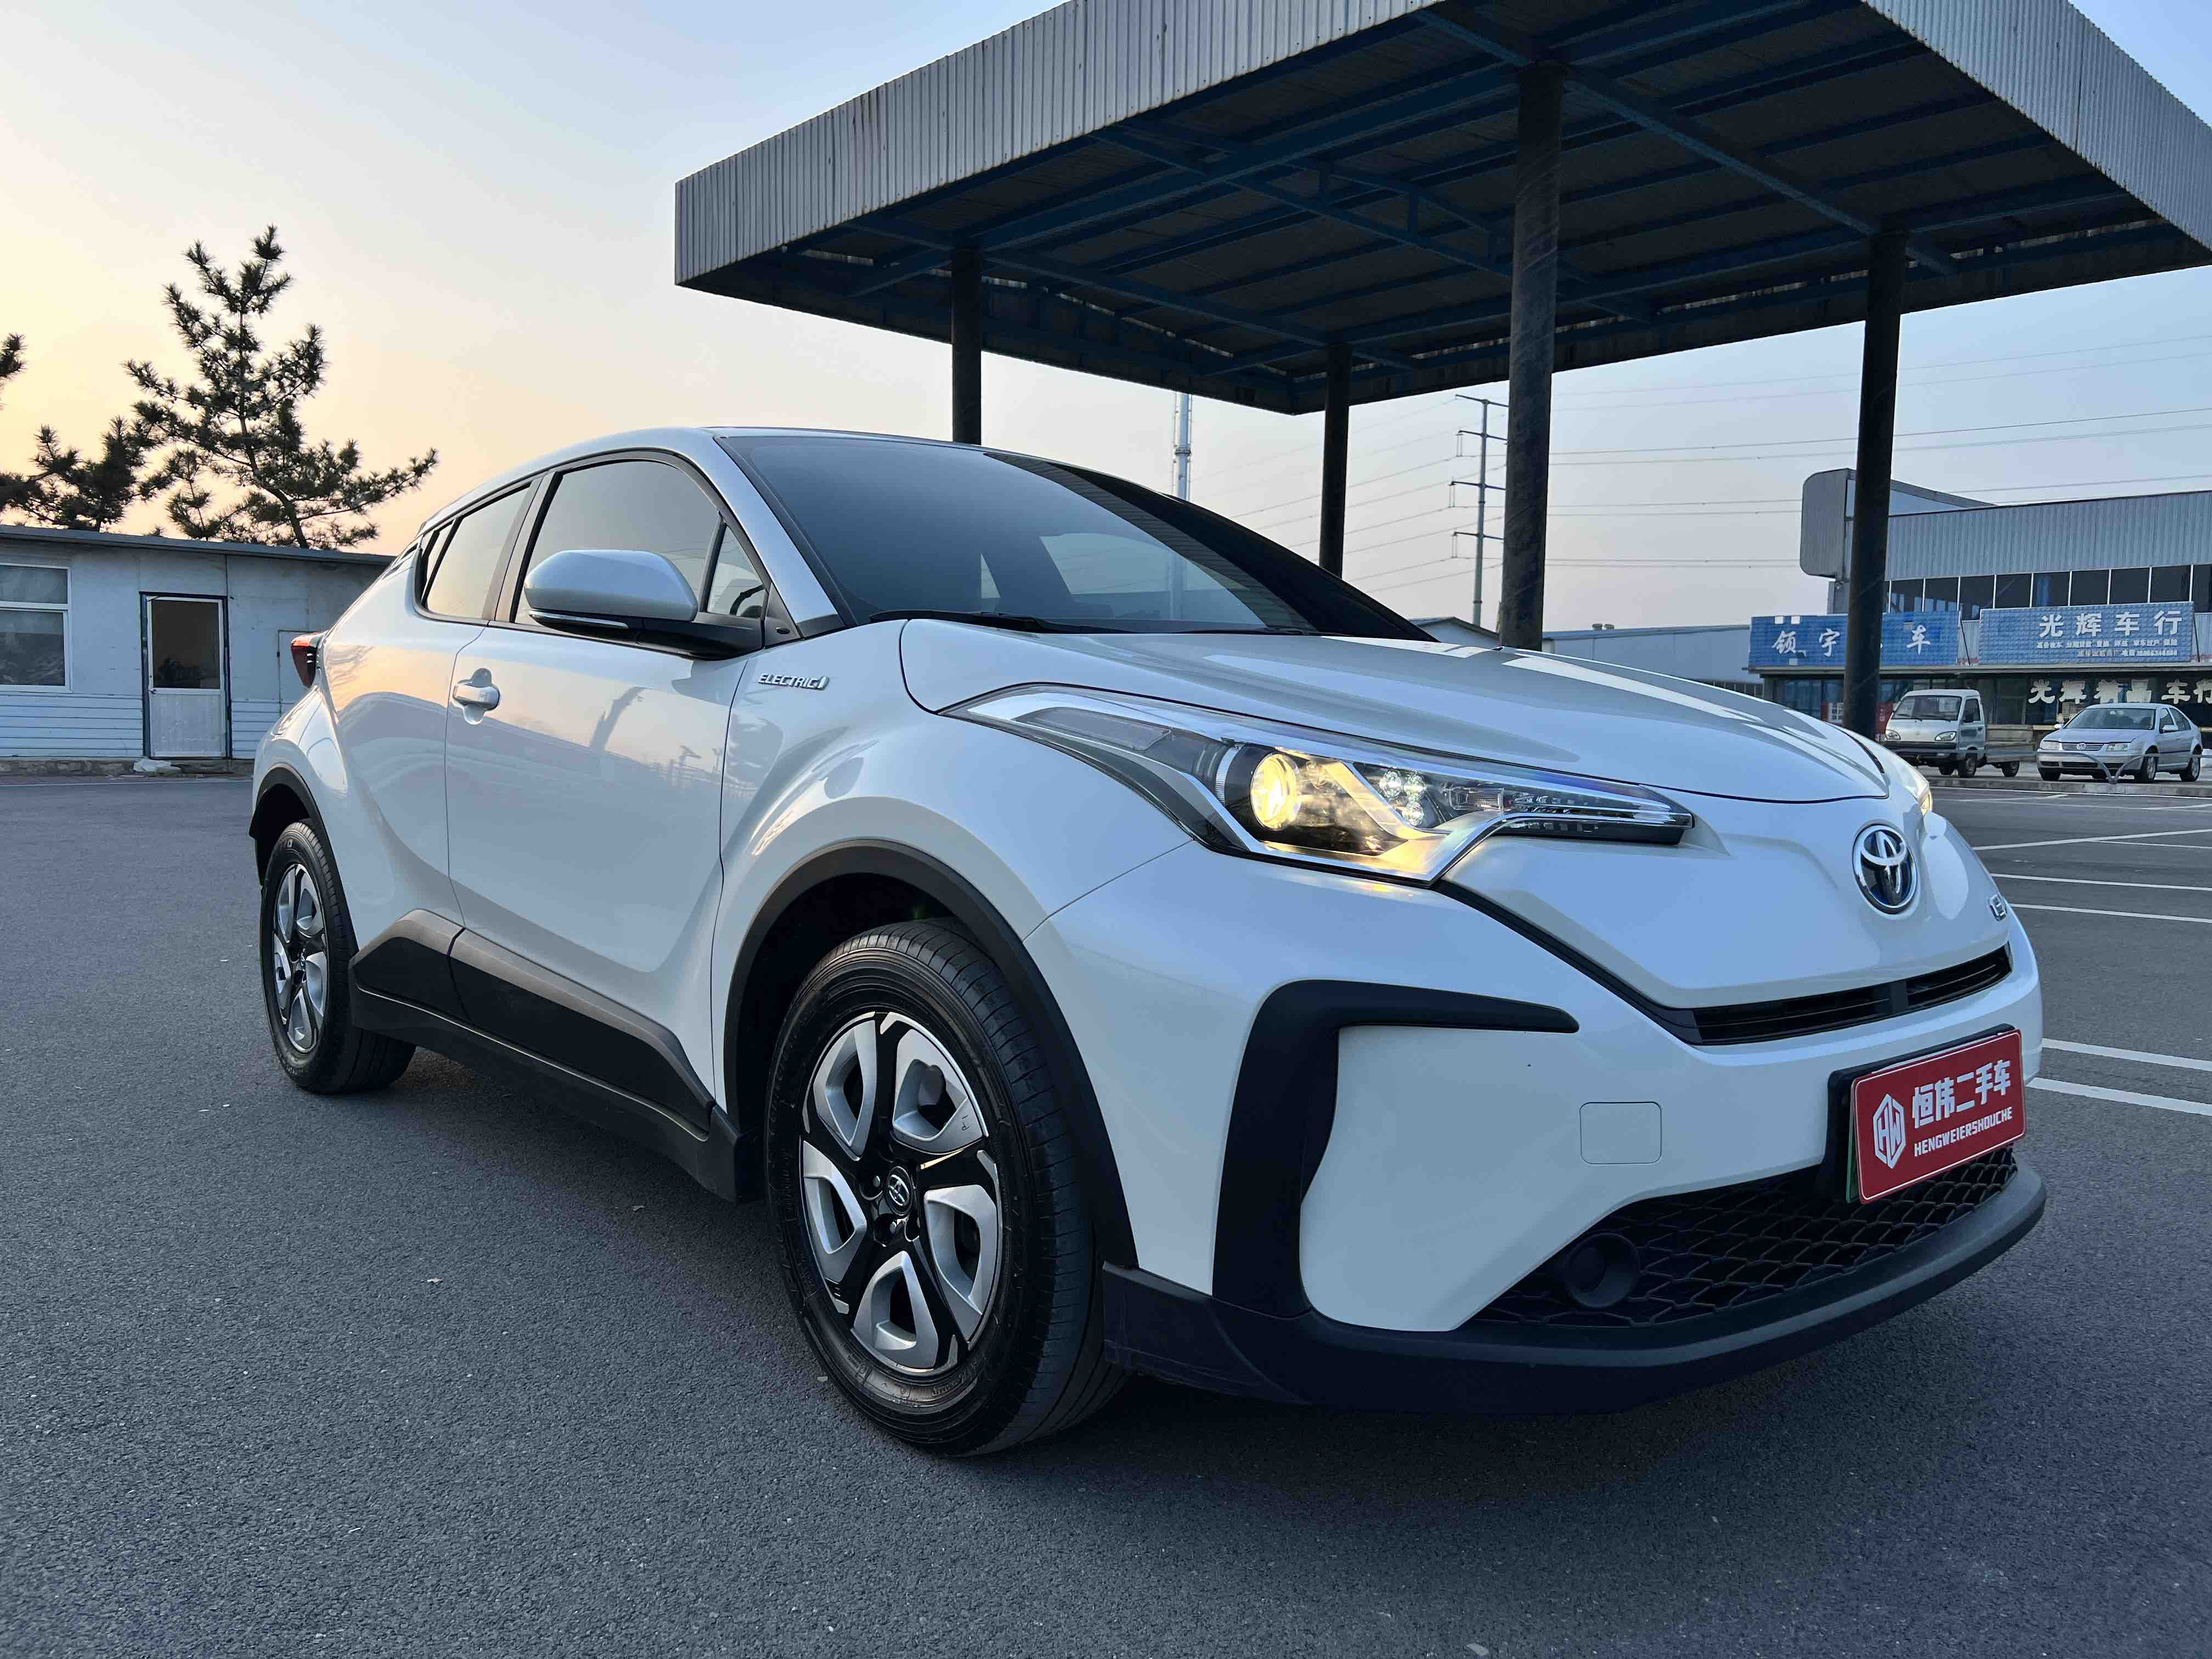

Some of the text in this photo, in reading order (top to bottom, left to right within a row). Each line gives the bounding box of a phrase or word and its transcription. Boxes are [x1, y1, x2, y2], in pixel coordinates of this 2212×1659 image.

[2039, 610, 2182, 637] 光辉车行
[758, 673, 819, 688] ELECTRIC
[1912, 1059, 2011, 1129] 恒伟二手车
[1914, 1107, 2013, 1157] HENGWEIERSHOUCHE
